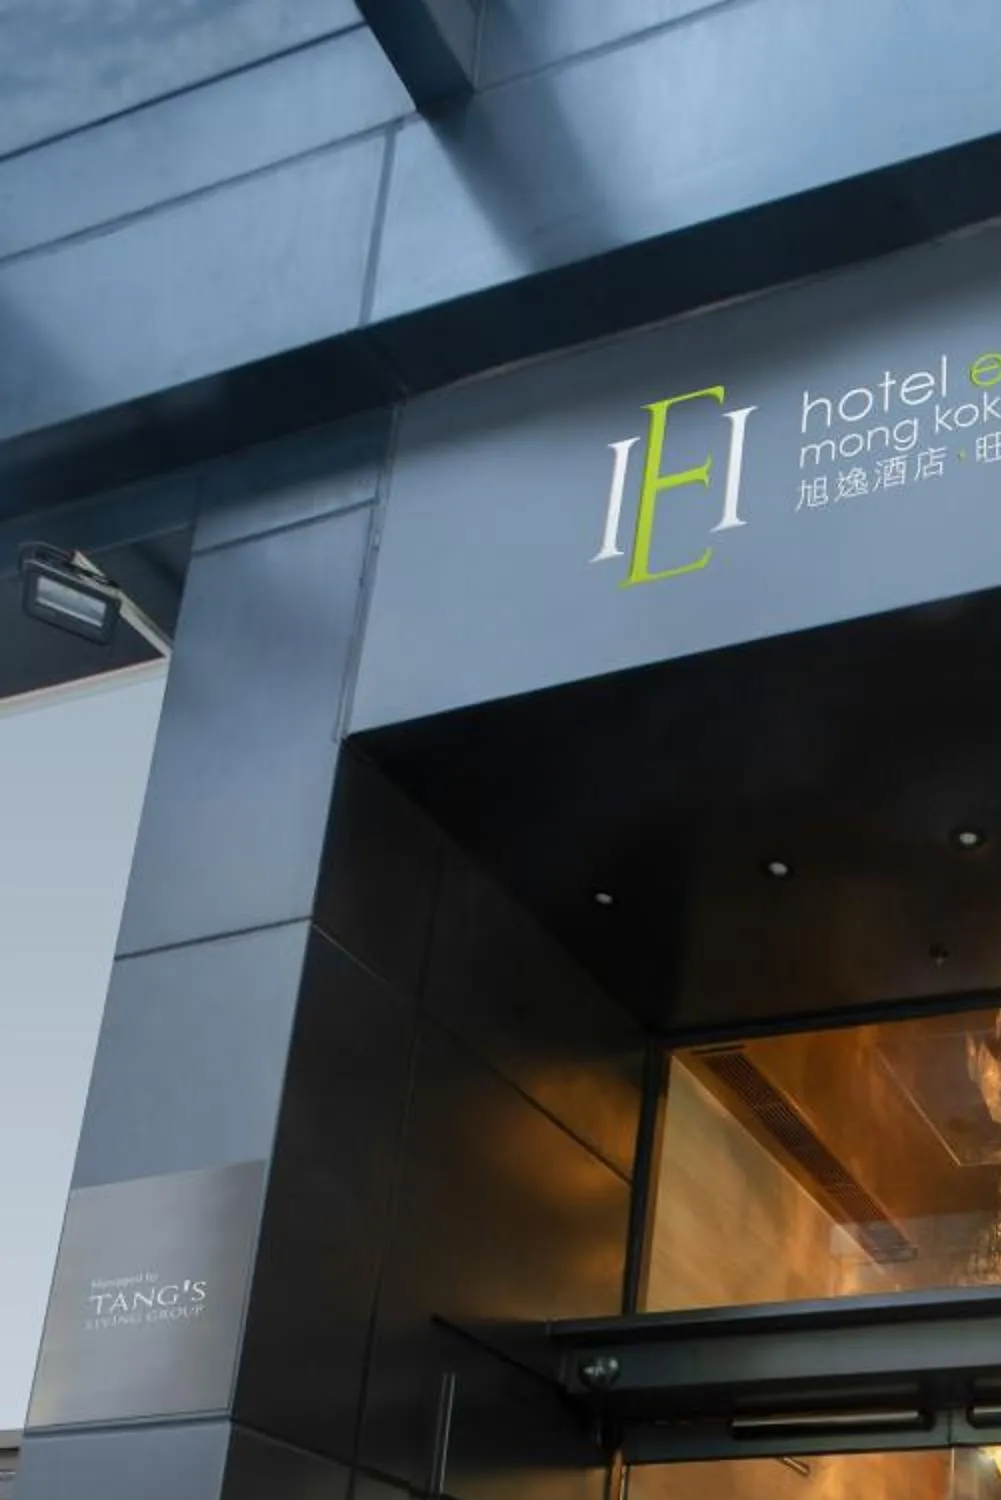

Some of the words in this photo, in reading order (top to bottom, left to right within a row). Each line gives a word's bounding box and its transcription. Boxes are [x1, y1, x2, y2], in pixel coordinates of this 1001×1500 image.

[801, 354, 948, 433] hotel
[799, 416, 919, 468] mong
[88, 1279, 207, 1315] TANG'S
